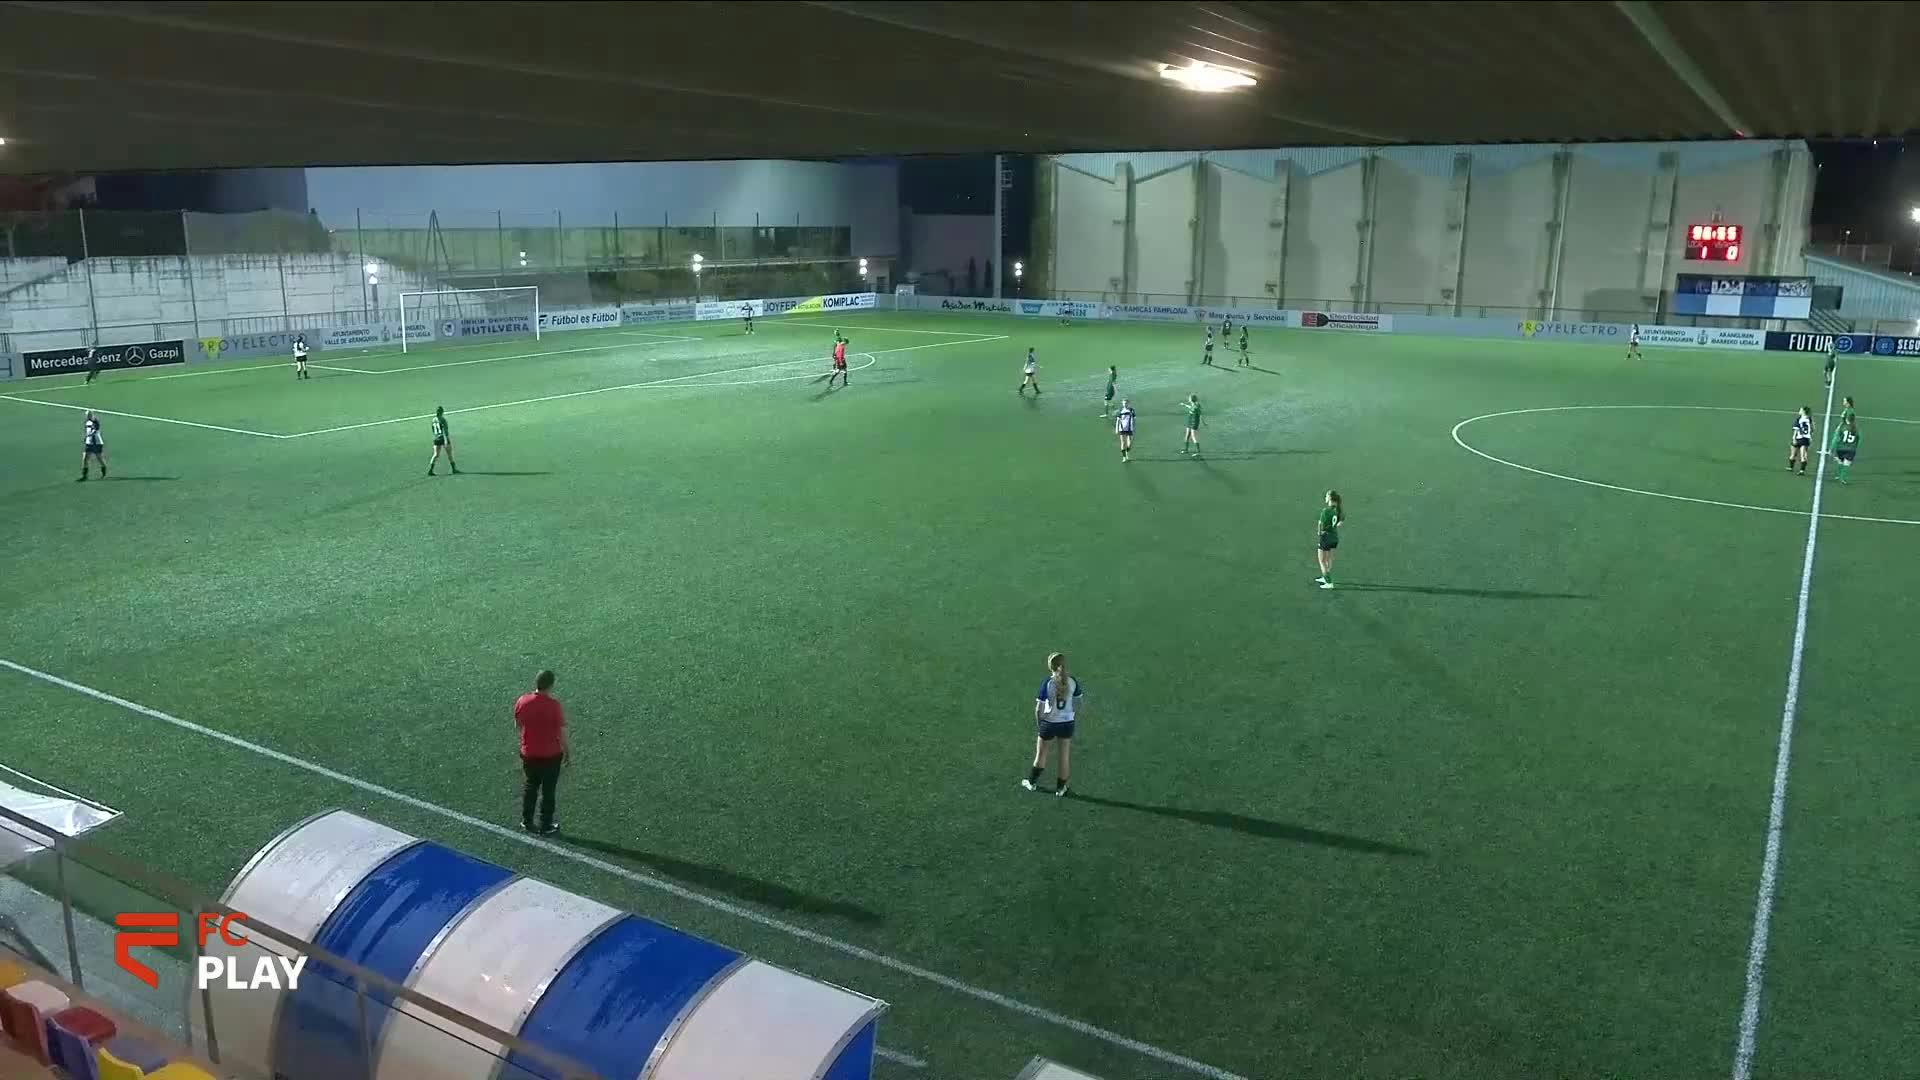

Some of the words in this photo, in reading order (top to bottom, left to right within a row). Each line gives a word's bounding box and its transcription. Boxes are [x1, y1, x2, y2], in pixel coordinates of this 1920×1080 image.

[1726, 245, 1738, 260] 0
[764, 300, 798, 312] JOYFER
[823, 296, 860, 308] KOMIPLAC
[580, 315, 590, 324] es
[461, 323, 530, 336] MUTILVERA
[1517, 321, 1618, 335] PROYELECTRO
[1788, 333, 1833, 352] FUTUR
[31, 352, 121, 370] Mercedesenz
[149, 347, 179, 360] Gazpi
[1843, 430, 1856, 443] 15
